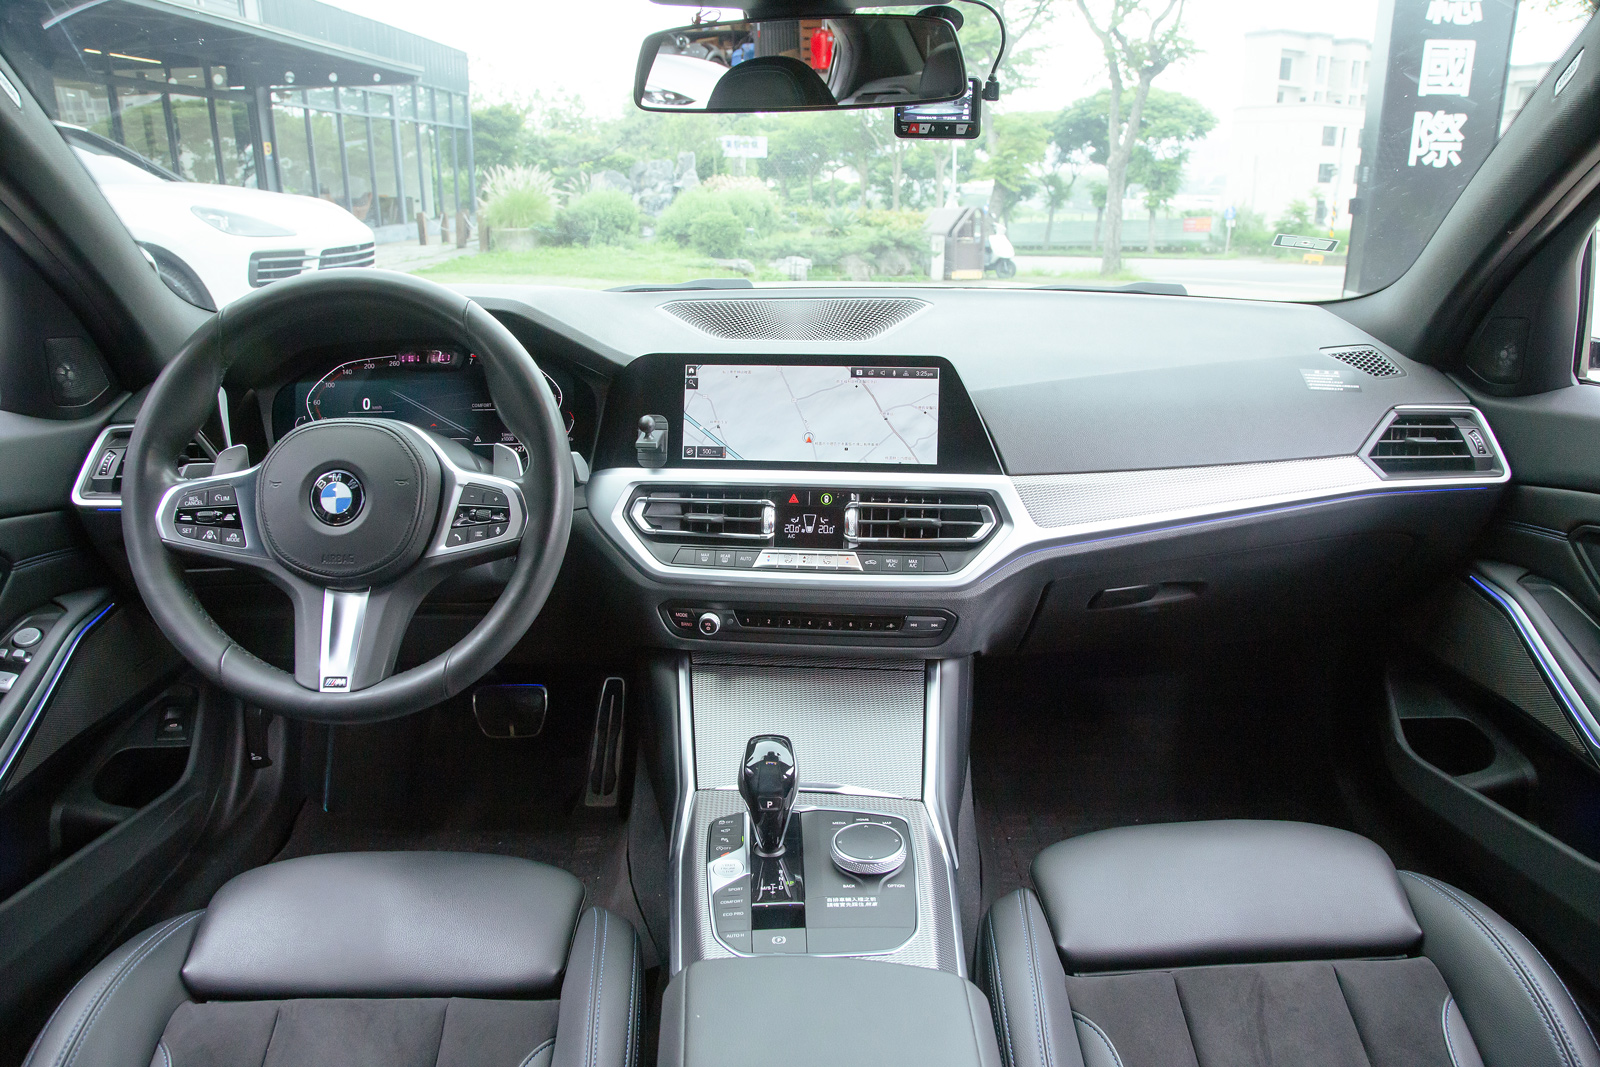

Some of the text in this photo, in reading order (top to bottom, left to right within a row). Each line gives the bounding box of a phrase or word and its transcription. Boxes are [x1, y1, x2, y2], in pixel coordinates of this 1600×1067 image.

[362, 398, 371, 410] 0
[317, 473, 358, 490] BMW
[767, 800, 773, 808] P
